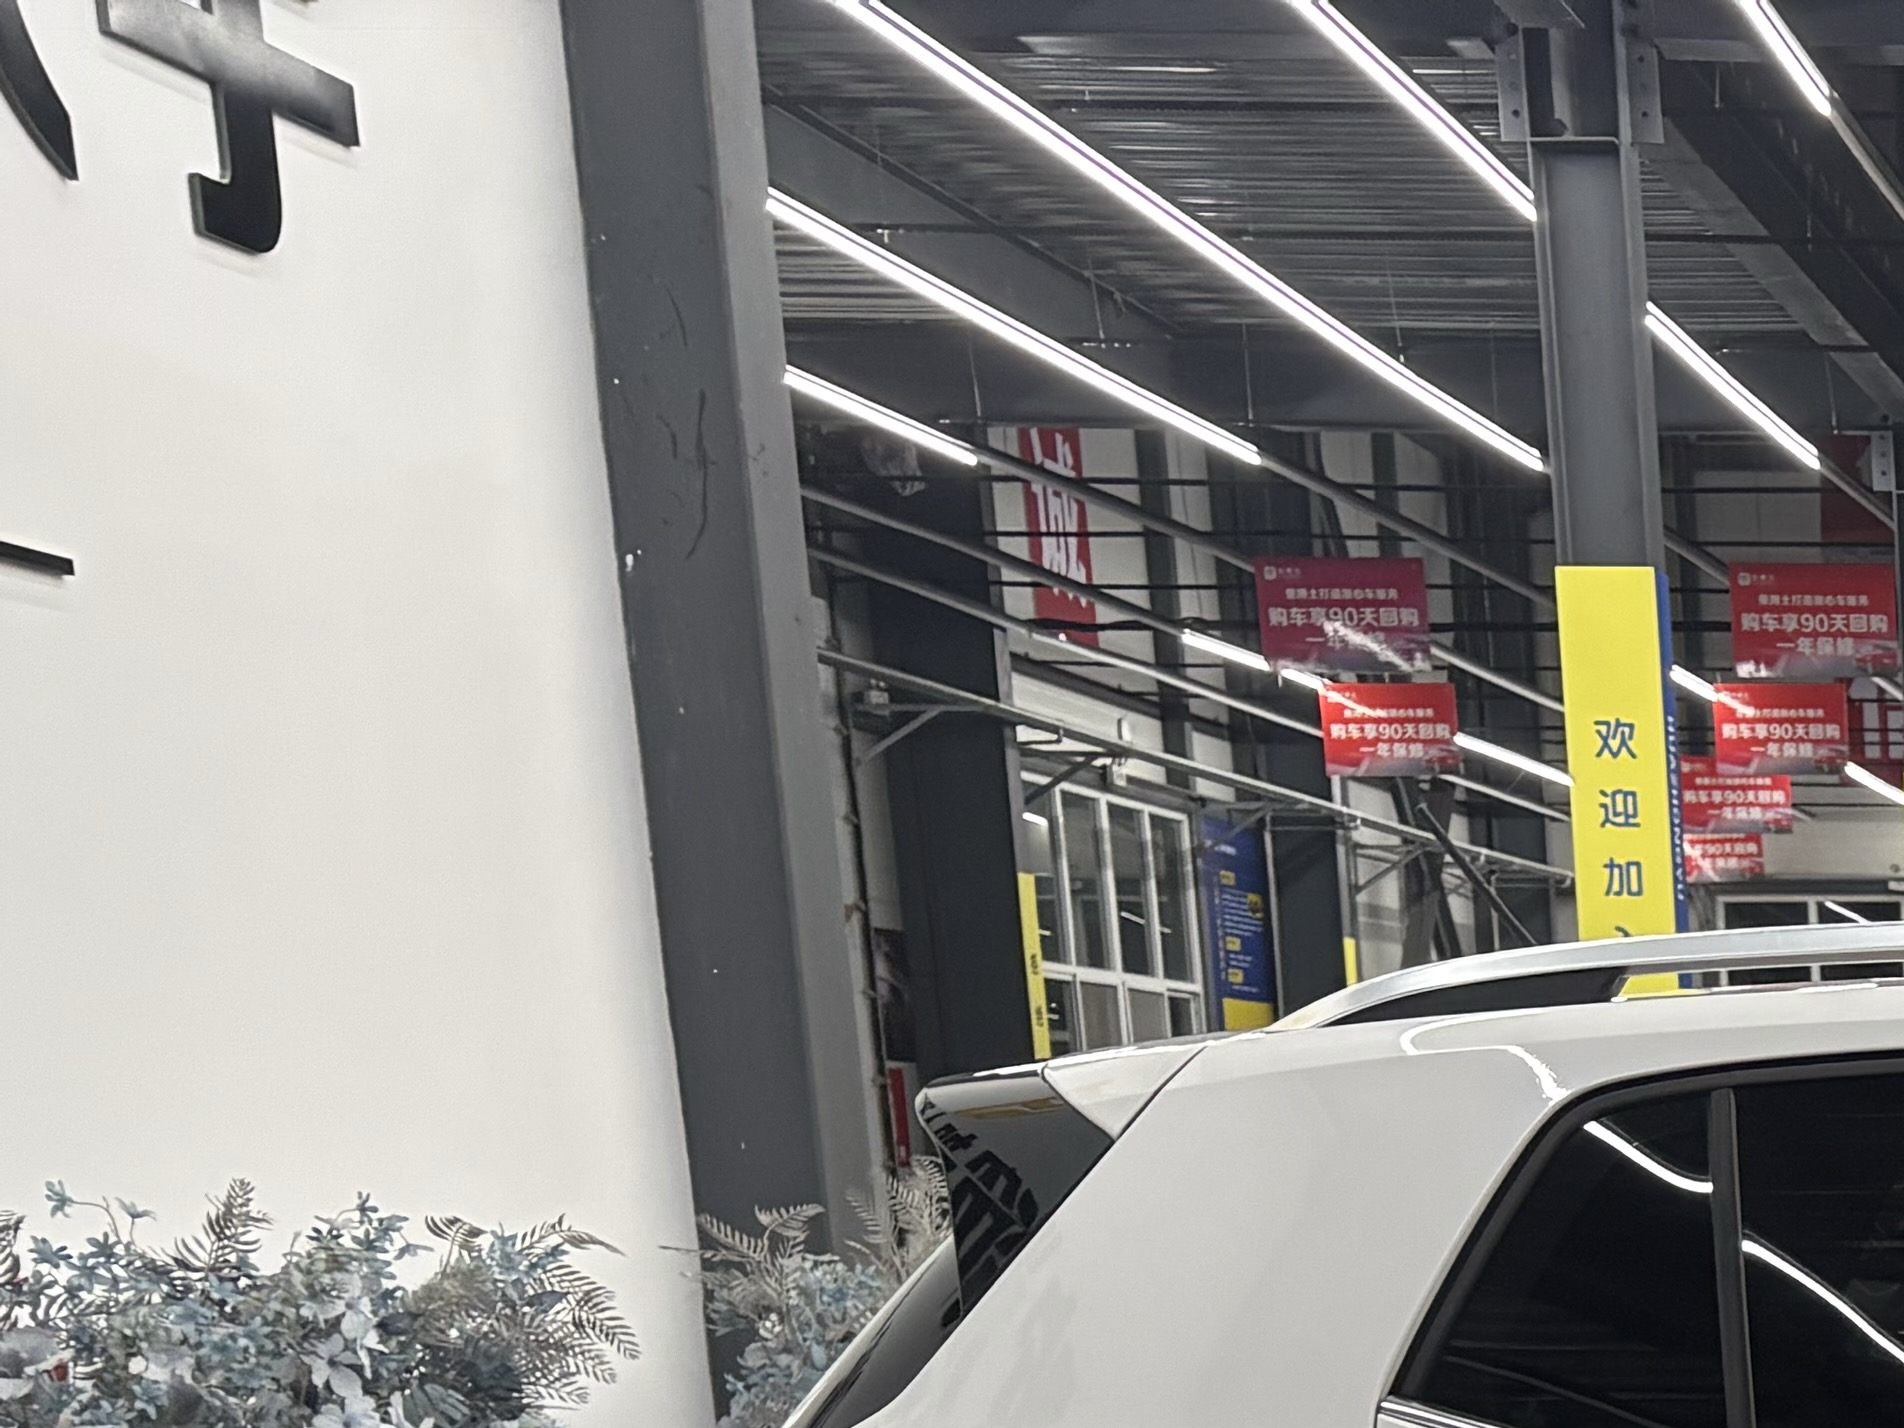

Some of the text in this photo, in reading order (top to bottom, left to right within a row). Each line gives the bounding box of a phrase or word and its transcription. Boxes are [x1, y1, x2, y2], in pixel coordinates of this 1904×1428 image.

[1741, 613, 1888, 632] 购车享90天回购
[1776, 637, 1854, 656] 一年保修
[1330, 723, 1450, 739] 购车享90天回购
[1721, 723, 1840, 739] 购车享90天回购
[1593, 718, 1646, 938] 欢迎加
